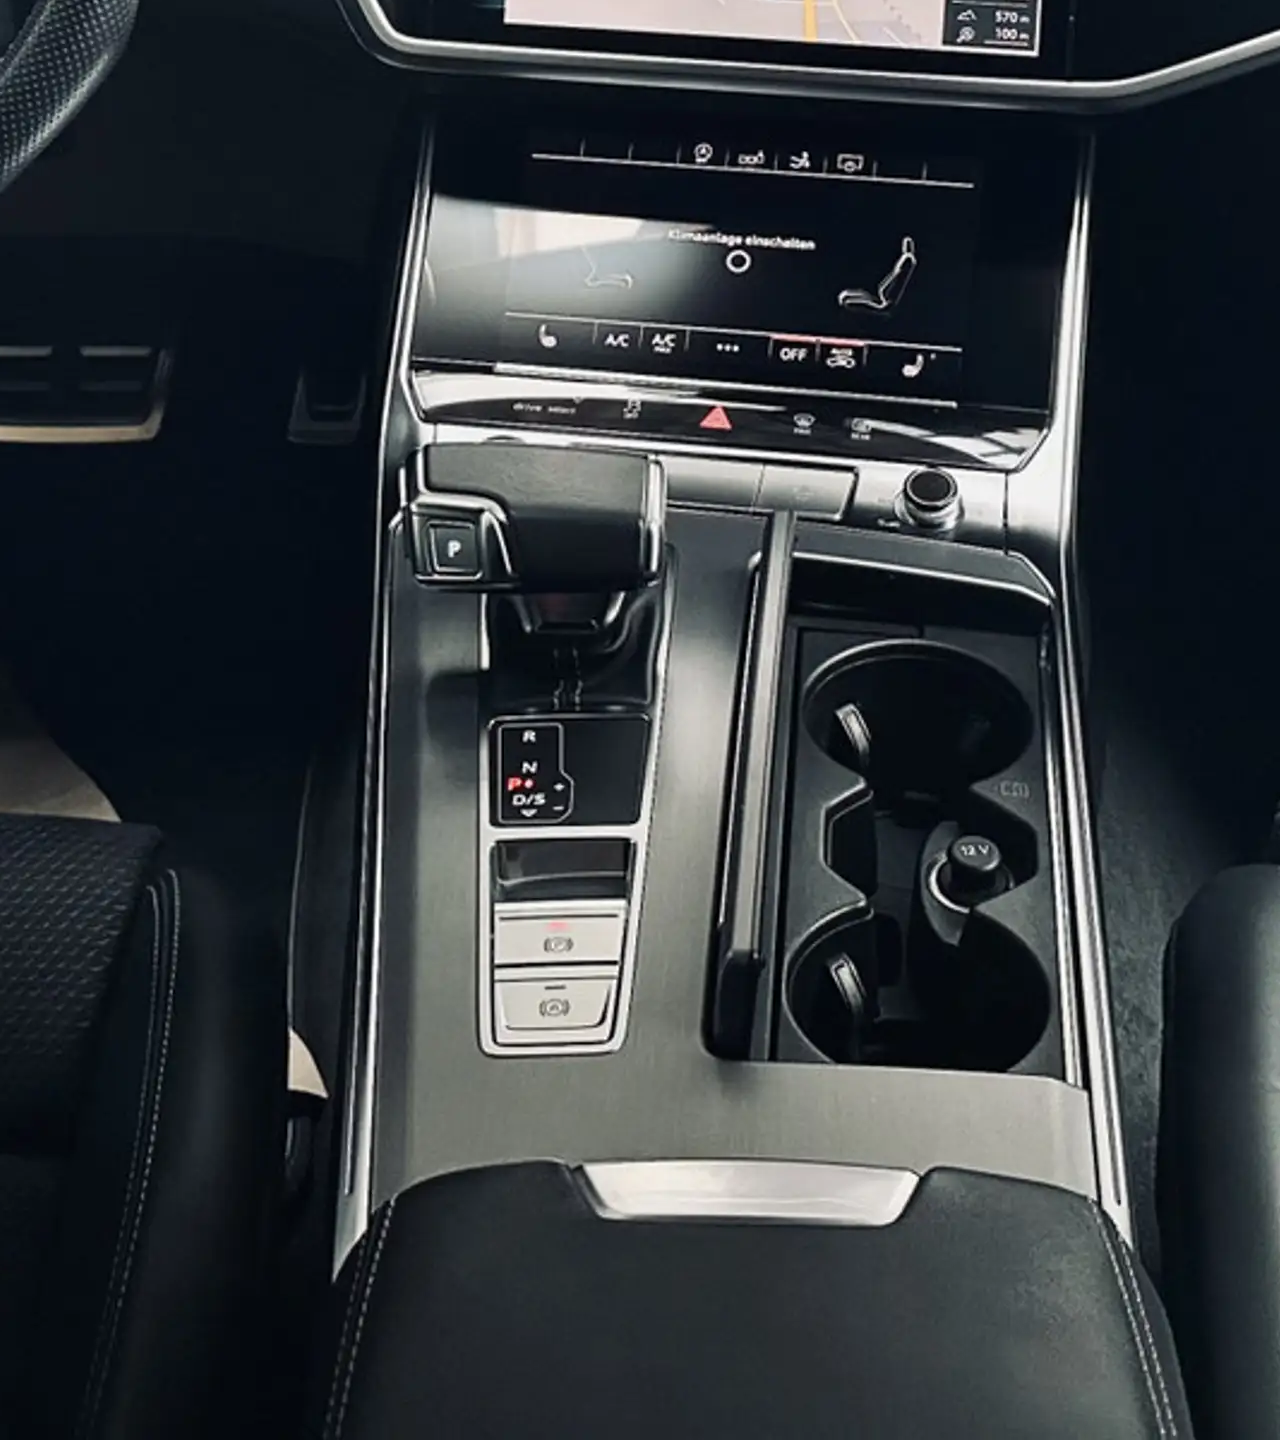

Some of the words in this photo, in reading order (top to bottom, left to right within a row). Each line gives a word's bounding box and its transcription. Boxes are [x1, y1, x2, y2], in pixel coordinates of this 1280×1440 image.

[668, 228, 742, 246] Klimaanlage
[745, 235, 816, 250] einschalten
[604, 333, 630, 348] A/C
[651, 333, 677, 347] A/C
[779, 347, 808, 362] OFF
[448, 540, 462, 558] P
[522, 729, 537, 743] R
[522, 761, 538, 774] N
[507, 777, 523, 791] P
[512, 792, 546, 807] D/S
[961, 844, 976, 856] 12
[978, 844, 989, 855] V
